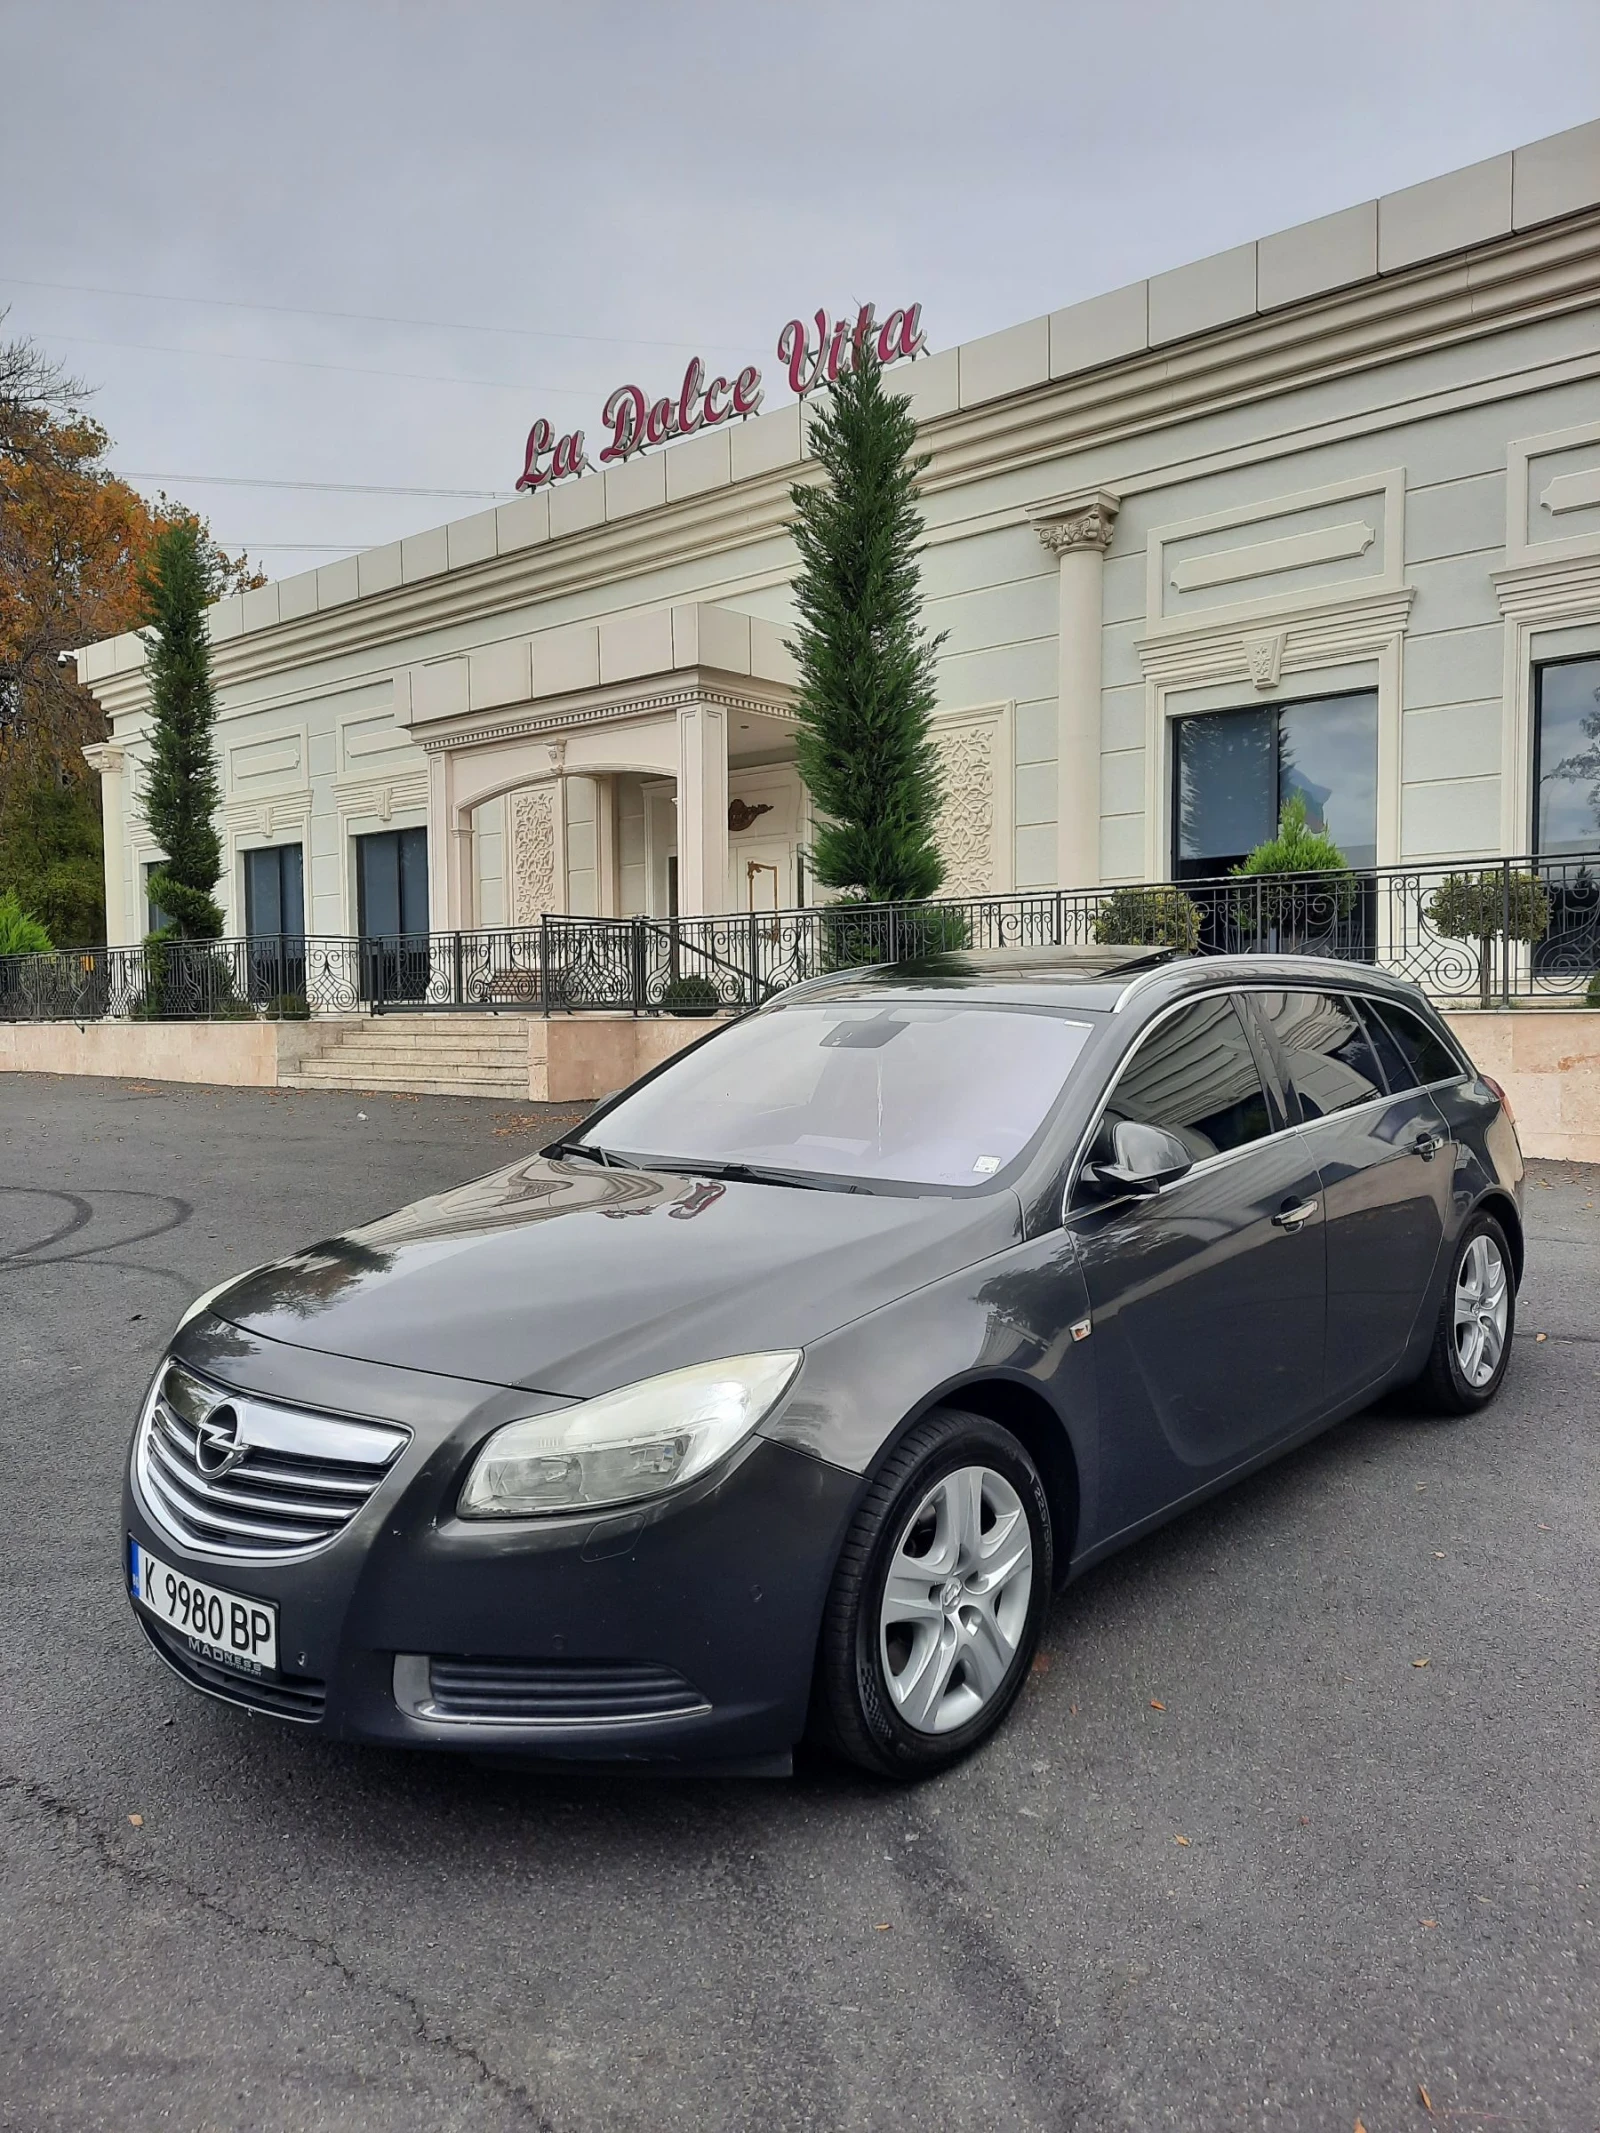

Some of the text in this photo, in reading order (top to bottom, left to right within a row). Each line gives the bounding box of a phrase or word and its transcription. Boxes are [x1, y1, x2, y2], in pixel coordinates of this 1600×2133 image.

[515, 302, 927, 491] La Dolce Vita
[145, 1556, 271, 1656] K 9980 BP
[188, 1636, 262, 1672] MADNESS
